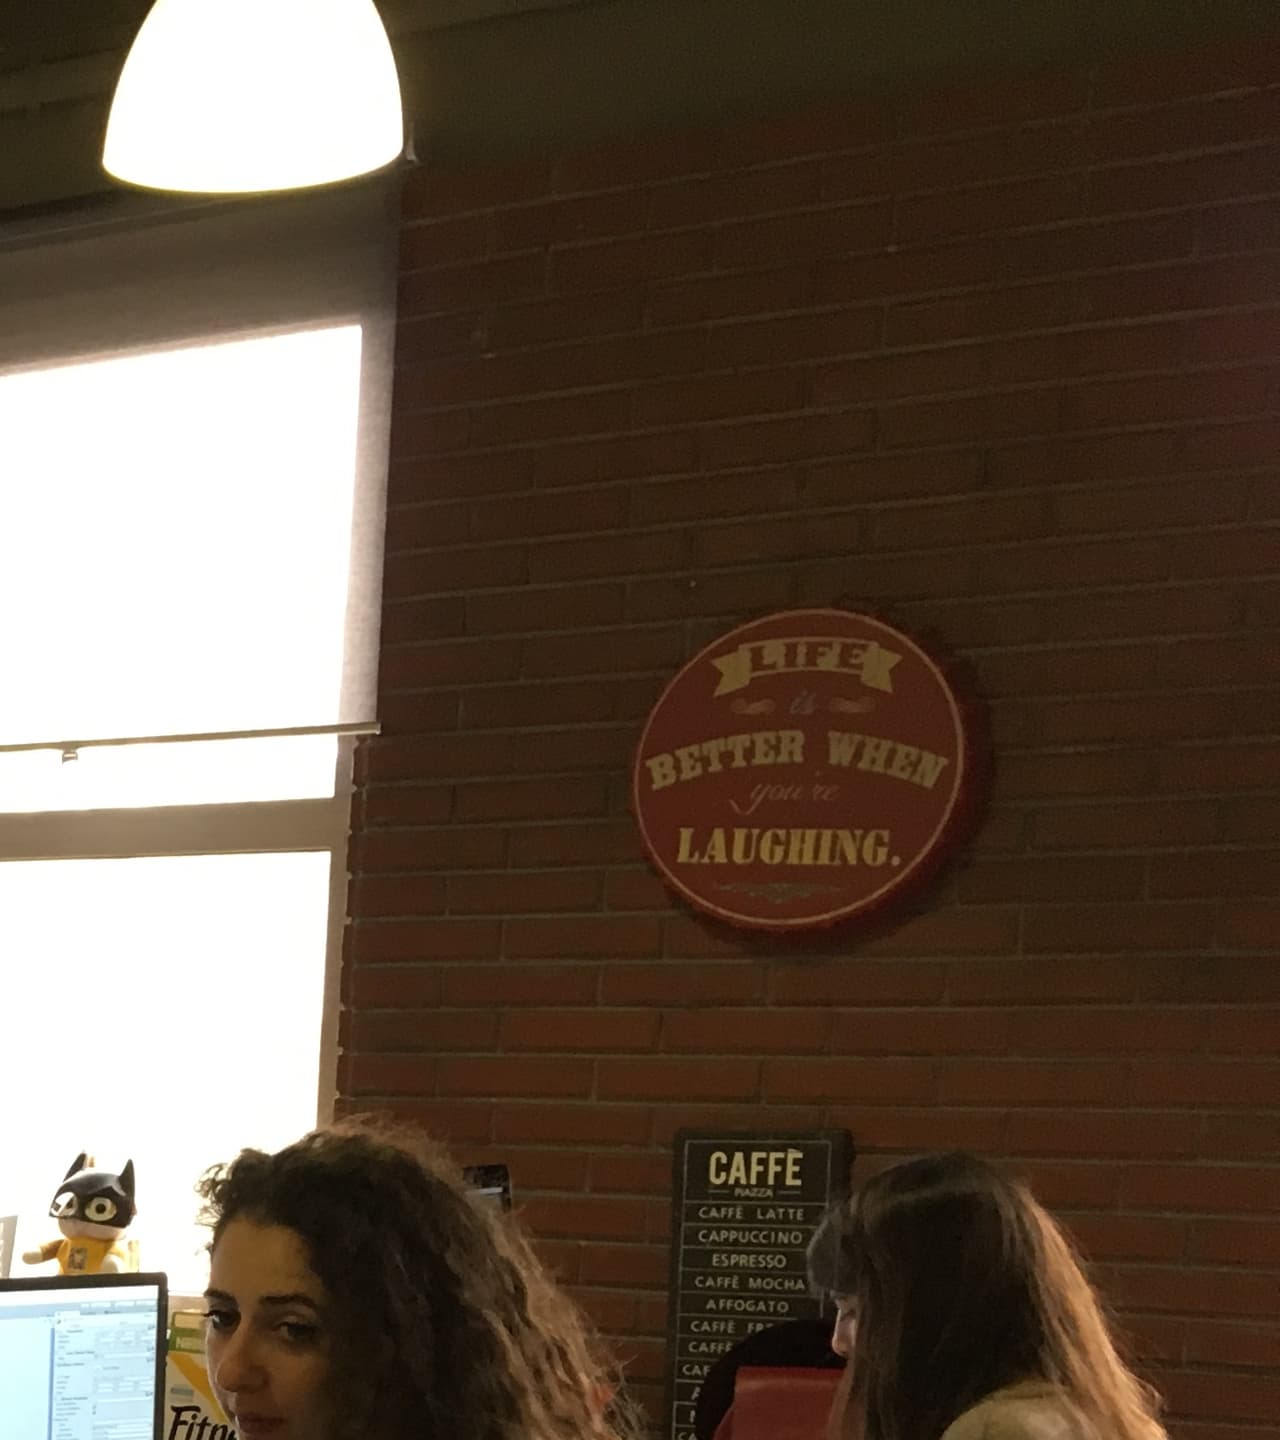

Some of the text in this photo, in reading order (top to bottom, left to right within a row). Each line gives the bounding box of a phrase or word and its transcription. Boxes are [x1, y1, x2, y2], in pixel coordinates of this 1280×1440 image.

[750, 640, 868, 670] LIFE
[646, 729, 949, 791] BETTER WHEN
[676, 827, 902, 867] LAUGHING.
[755, 1207, 805, 1221] LATTE
[697, 1229, 803, 1245] CAPPUCCINO
[711, 1252, 788, 1269] ESPRESSO
[748, 1277, 806, 1291] MOCHA
[705, 1299, 790, 1313] AFFOGATO
